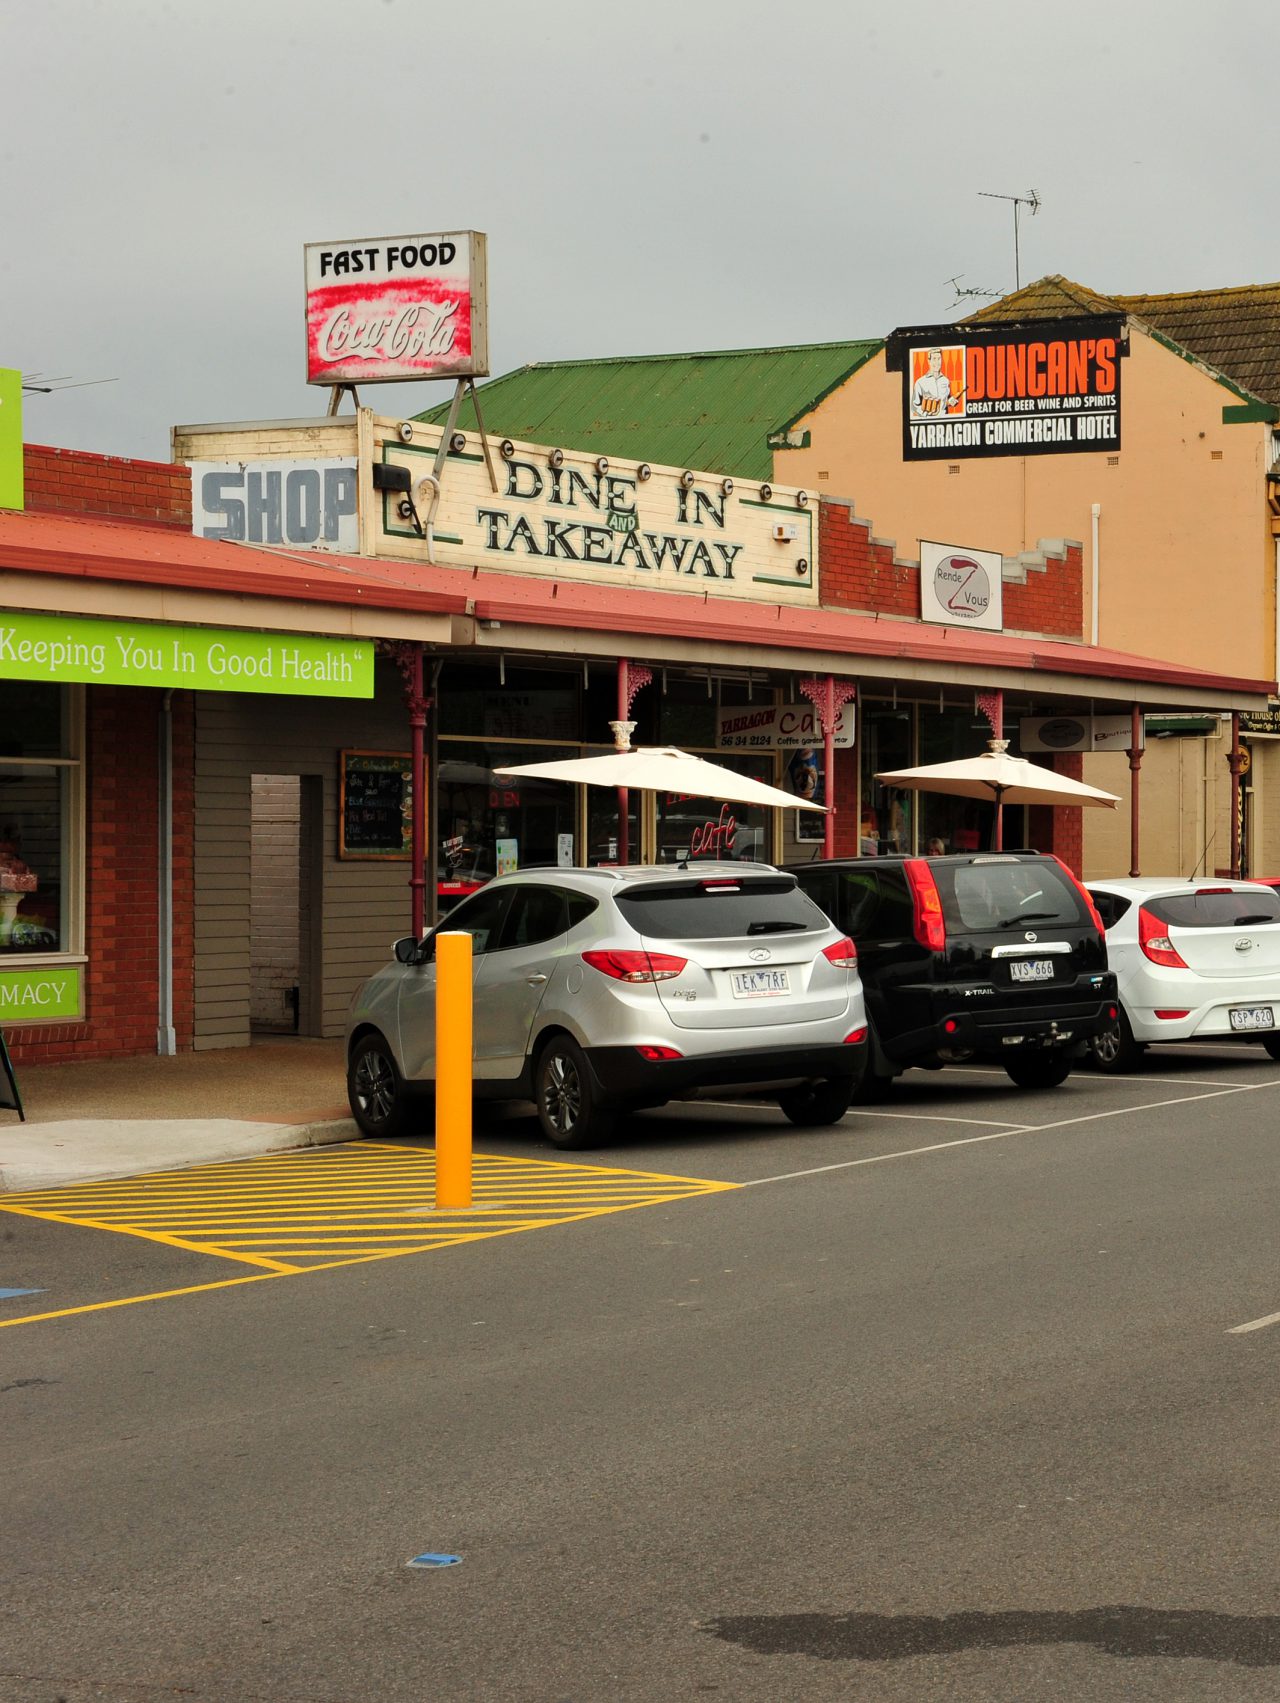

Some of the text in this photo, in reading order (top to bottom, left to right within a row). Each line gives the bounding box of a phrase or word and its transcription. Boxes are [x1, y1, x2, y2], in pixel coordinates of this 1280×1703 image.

[320, 243, 456, 277] FAST FOOD
[318, 299, 460, 363] Coca-Cola
[966, 338, 1116, 400] DUNCAN'S
[967, 395, 1116, 414] GREAT FOR BEER WINE AND SPIRITS
[910, 415, 1117, 449] YARRAGON COMMERCIAL HOTEL
[202, 468, 357, 544] SHOP
[504, 460, 726, 528] DINE IN
[608, 516, 637, 531] AND
[477, 510, 743, 579] TAKEAWAY
[937, 568, 962, 583] Rende
[965, 592, 988, 606] Vous
[0, 628, 105, 673] Keeping
[116, 636, 162, 670] You
[173, 641, 195, 673] In
[208, 643, 272, 677] Good
[721, 708, 776, 735] YARRAGON
[721, 737, 733, 746] 56
[735, 737, 747, 746] 34
[750, 736, 771, 746] 2124
[777, 737, 799, 745] Coffee
[736, 974, 758, 990] 1EK
[1011, 962, 1053, 977] XVS 666
[1231, 1011, 1272, 1024] YSP 620
